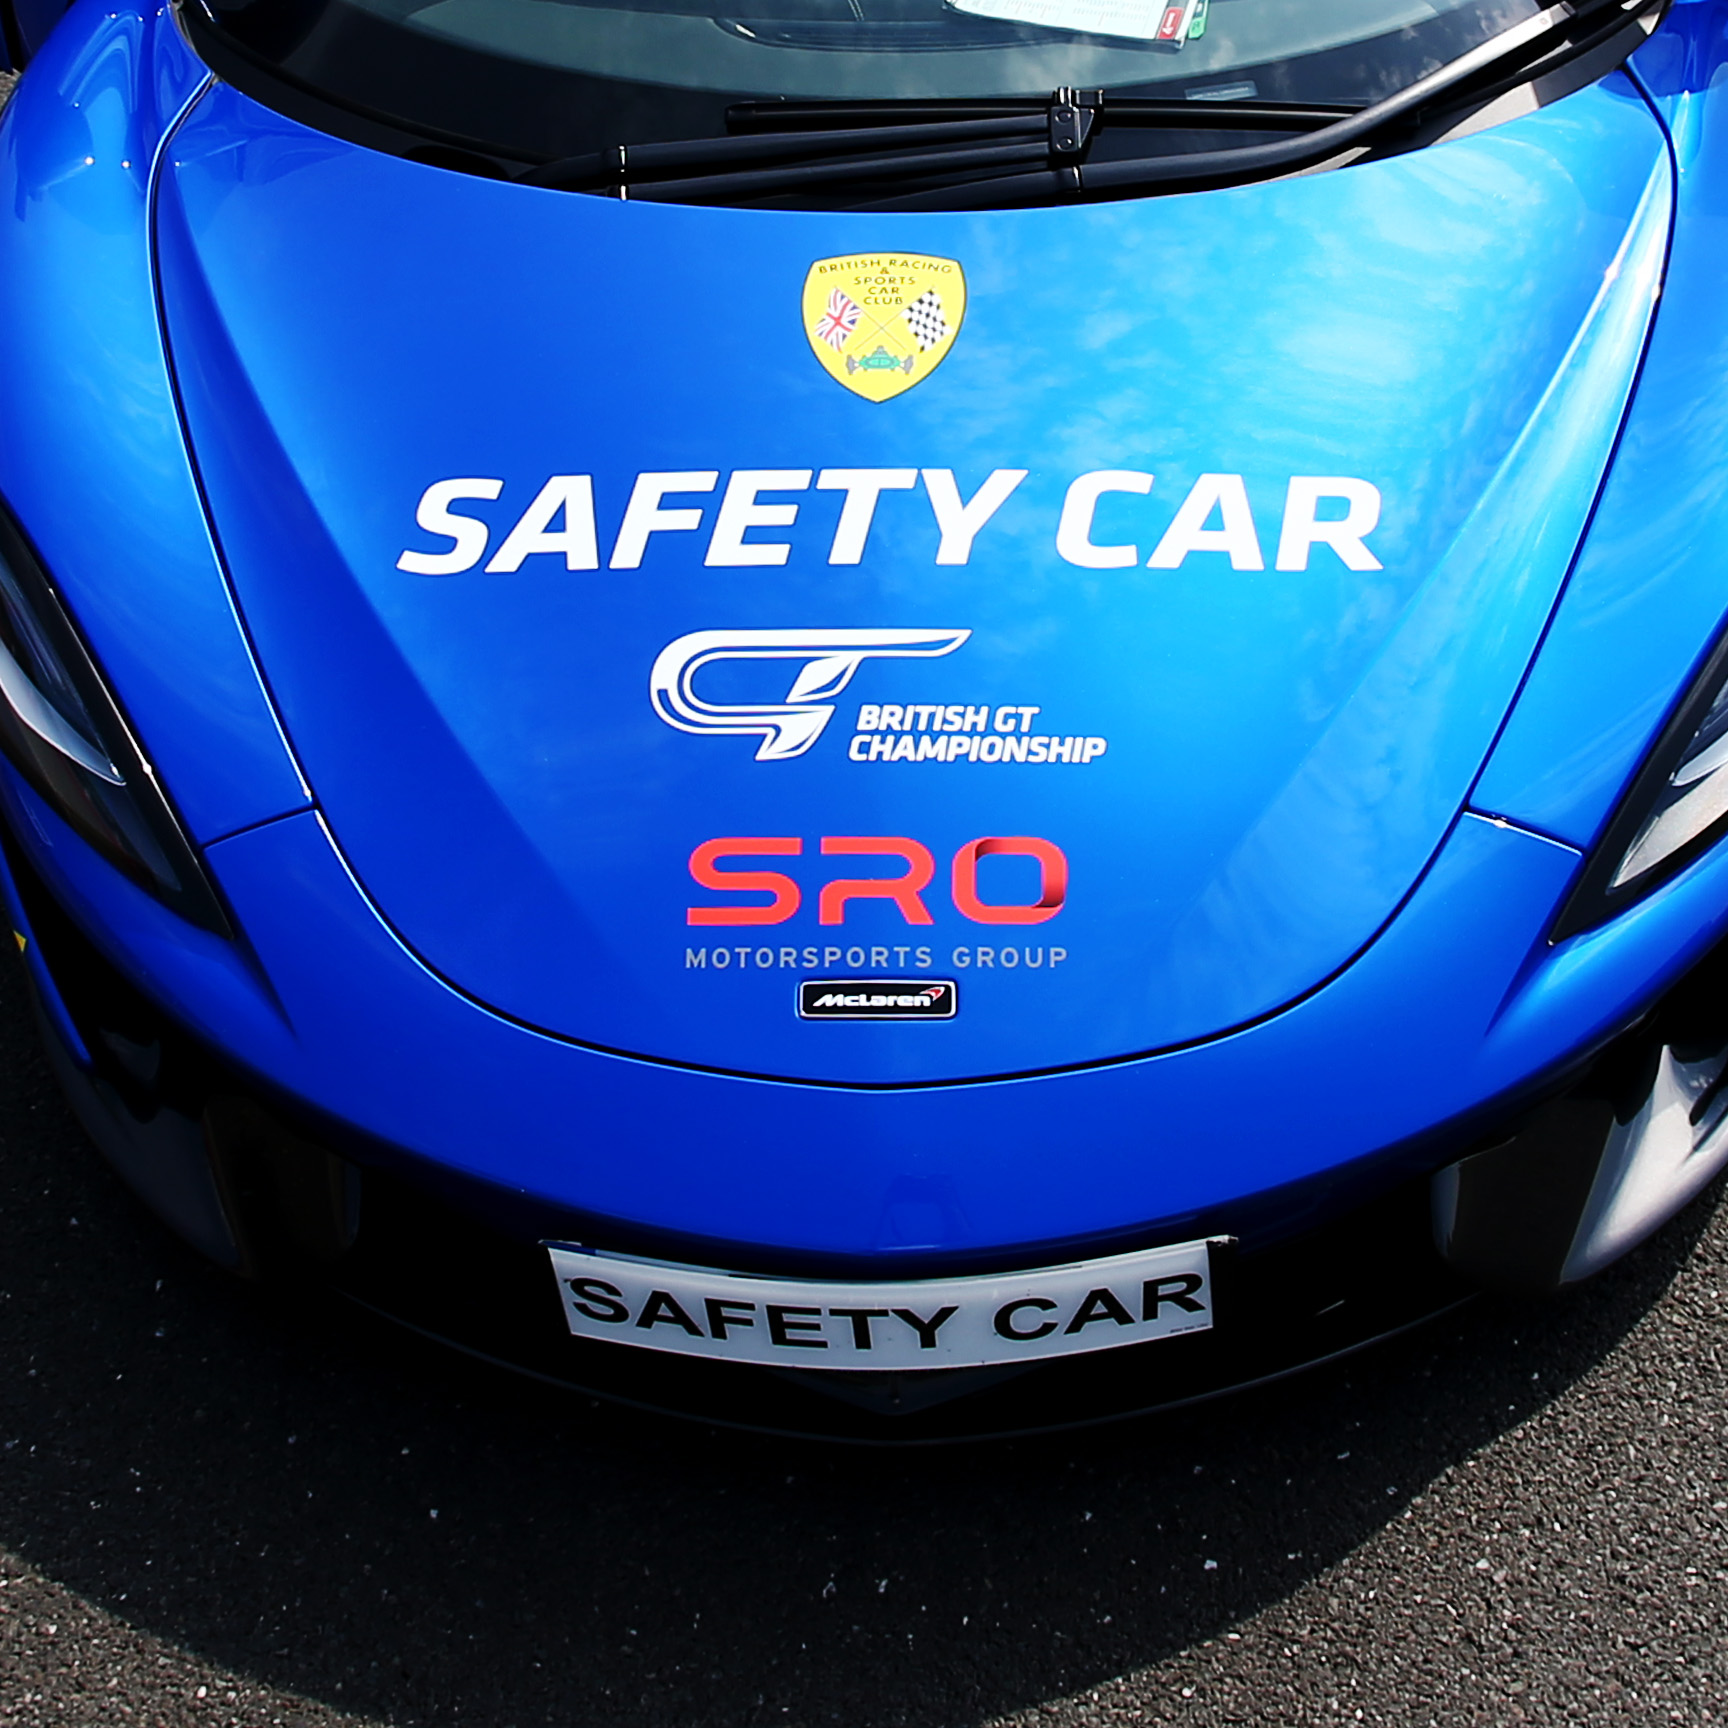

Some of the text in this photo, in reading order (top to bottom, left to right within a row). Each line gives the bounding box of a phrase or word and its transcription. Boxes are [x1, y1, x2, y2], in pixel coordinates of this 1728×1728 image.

[818, 258, 953, 274] BRITISH RACING
[879, 266, 890, 275] &
[853, 276, 917, 286] SPORTS
[867, 286, 900, 295] CAR
[863, 296, 904, 305] CLUB
[395, 468, 1384, 577] SAFETY CAR
[855, 704, 1041, 734] BRITISH GT
[848, 734, 1108, 764] CHAMPIONSHIP
[687, 836, 1069, 926] SRO
[685, 946, 1068, 969] MOTORSPORTS GROUP
[812, 991, 932, 1008] McLaren
[570, 1273, 1206, 1351] SAFETY CAR
